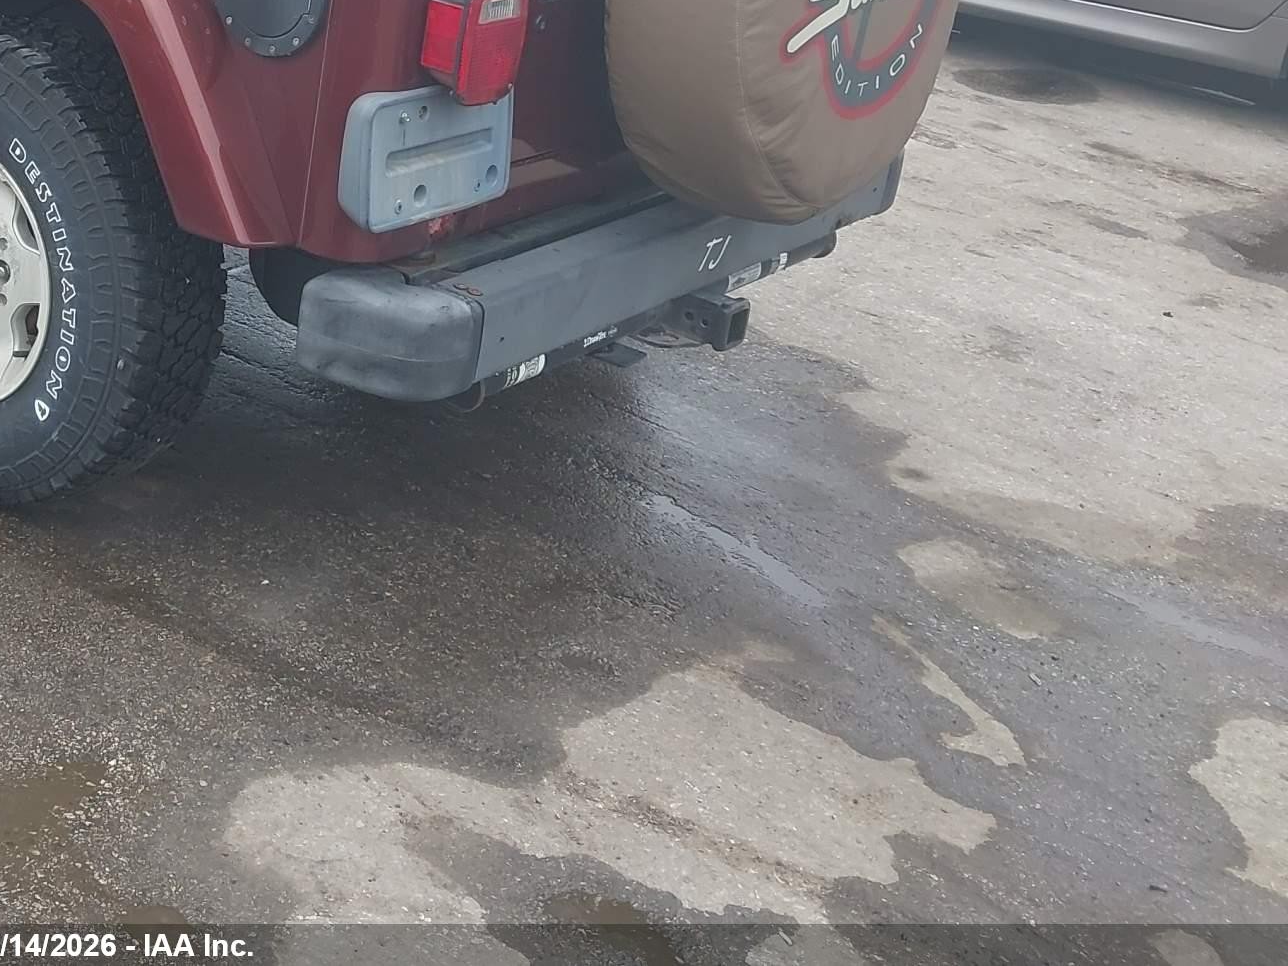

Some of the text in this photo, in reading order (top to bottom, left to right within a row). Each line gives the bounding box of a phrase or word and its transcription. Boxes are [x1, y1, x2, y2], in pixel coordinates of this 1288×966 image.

[830, 22, 924, 98] EDITION
[9, 138, 77, 400] DESTINATION
[698, 234, 732, 272] TJ
